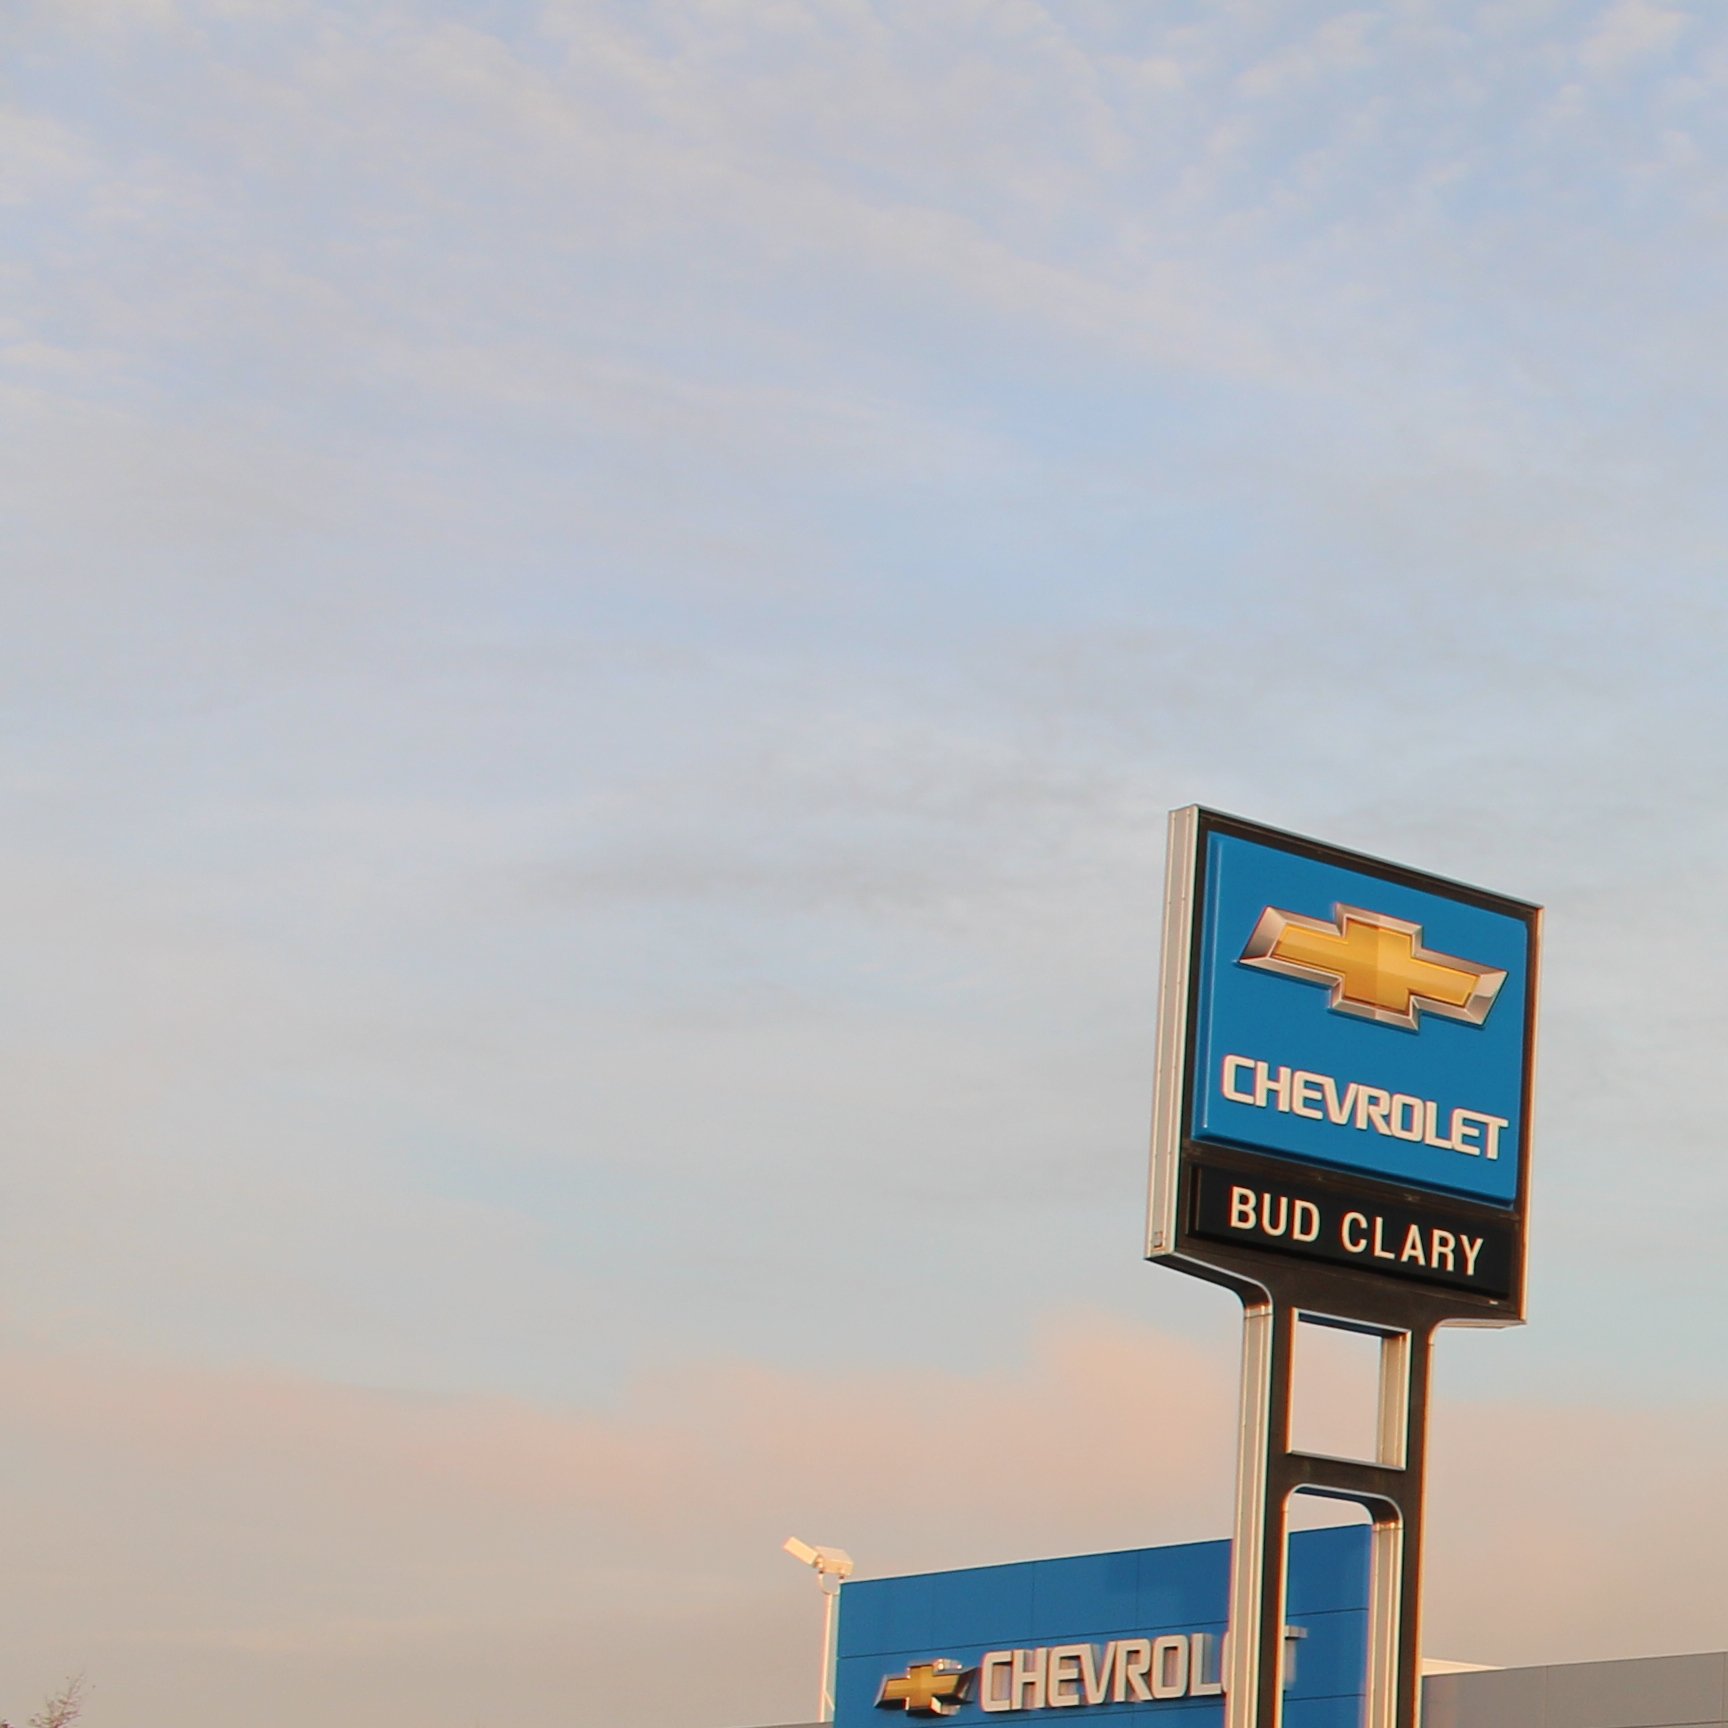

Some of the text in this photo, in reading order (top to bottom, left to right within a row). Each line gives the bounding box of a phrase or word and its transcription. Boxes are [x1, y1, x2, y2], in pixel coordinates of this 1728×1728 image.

[1221, 1053, 1510, 1161] CHEVROLET
[1229, 1184, 1485, 1277] BUD CLARY
[979, 1625, 1308, 1713] CHEVROL
